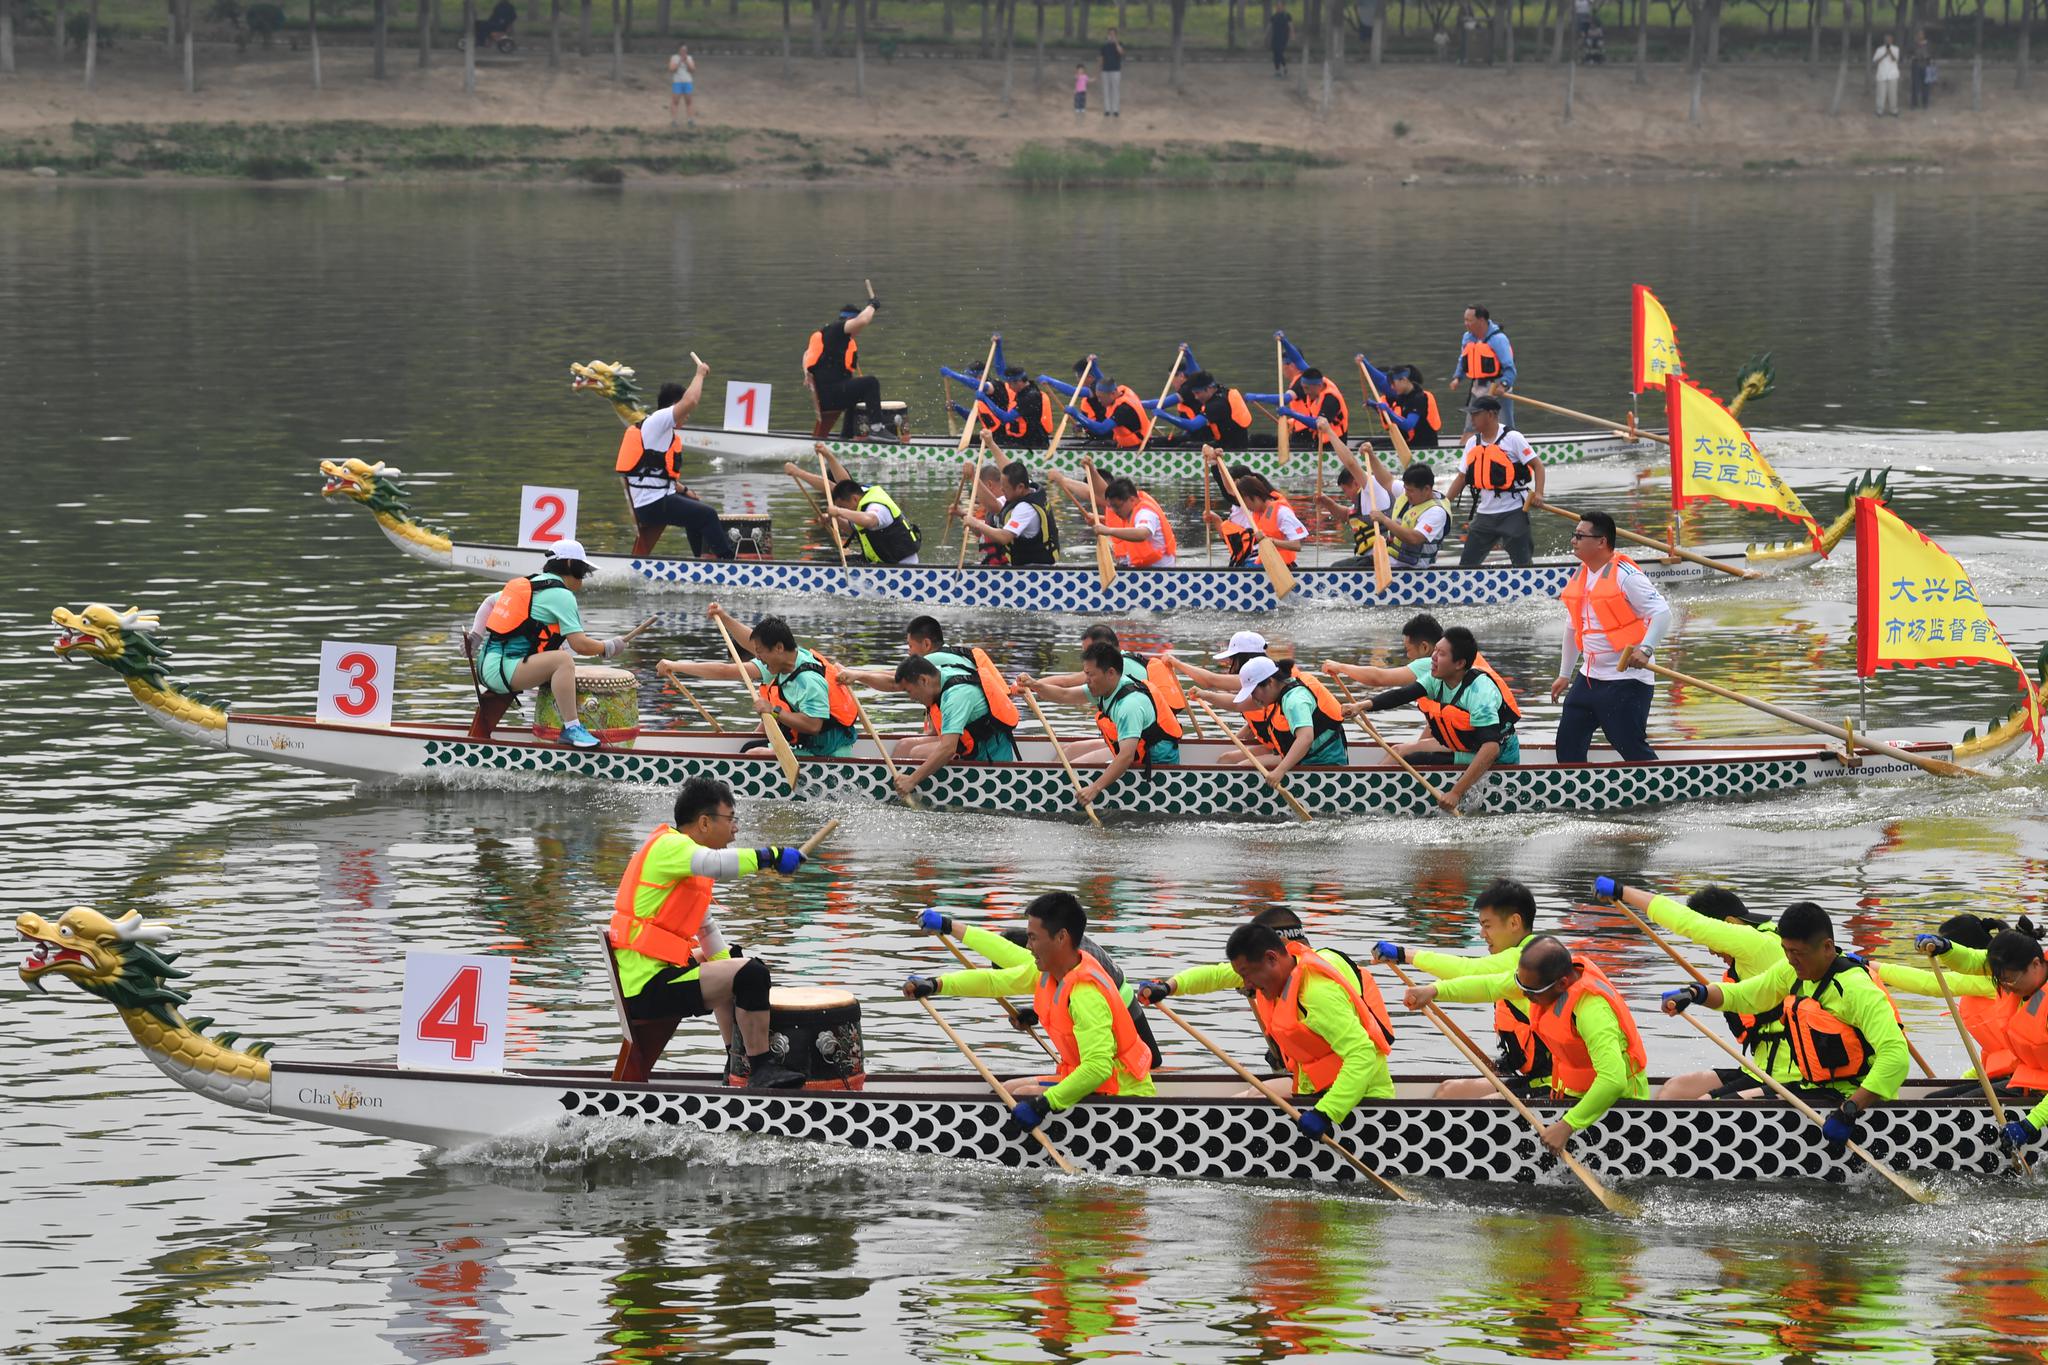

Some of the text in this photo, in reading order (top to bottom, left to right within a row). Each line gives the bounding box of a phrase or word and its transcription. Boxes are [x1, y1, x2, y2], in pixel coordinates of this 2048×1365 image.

[736, 388, 756, 427] 1
[1694, 436, 1754, 461] 大兴区
[530, 494, 566, 543] 2
[1890, 577, 1979, 603] 大兴区
[1885, 617, 2002, 646] 市场监督管
[333, 651, 379, 717] 3
[417, 965, 488, 1061] 4
